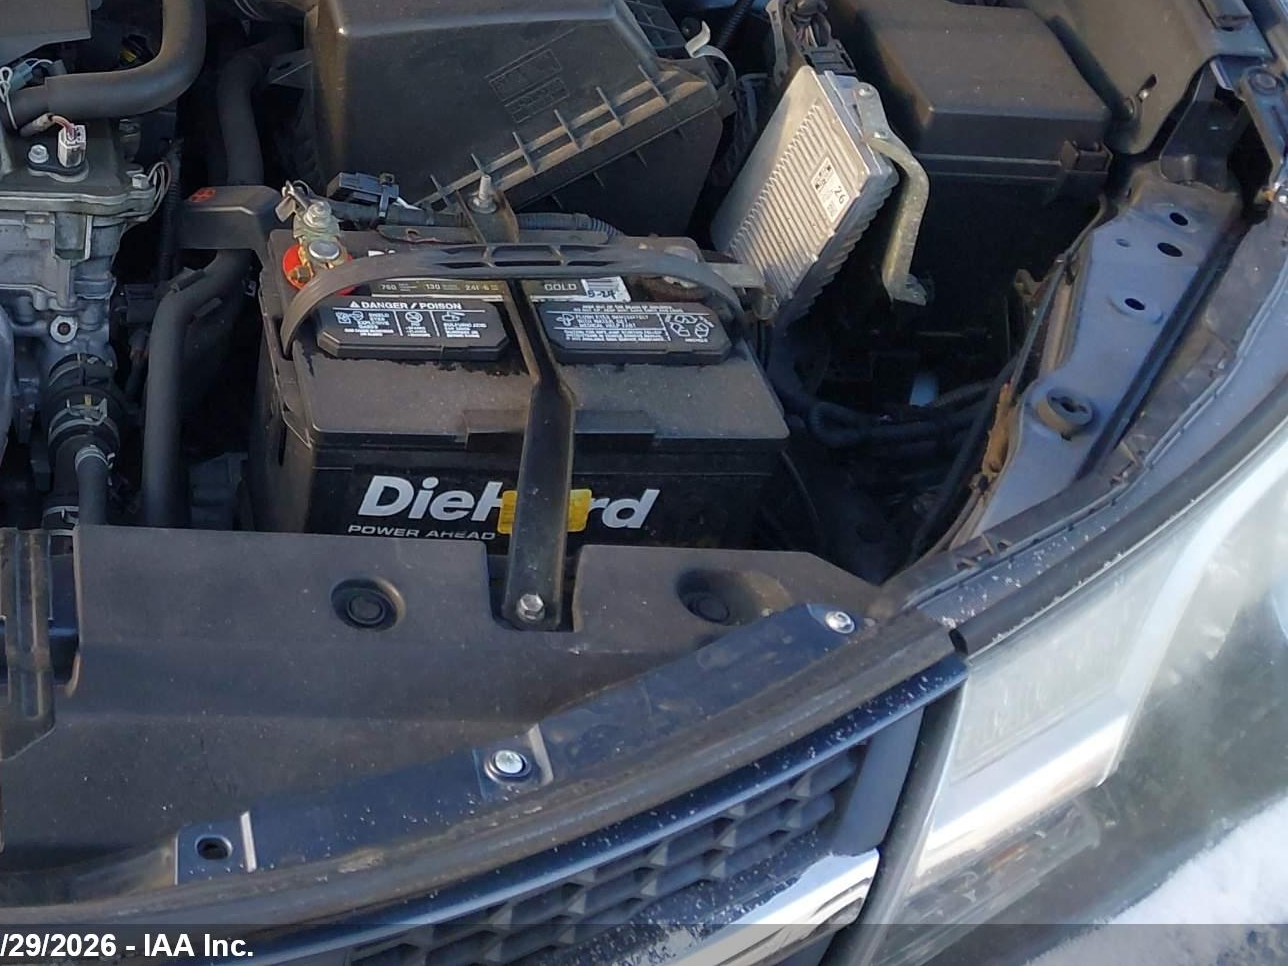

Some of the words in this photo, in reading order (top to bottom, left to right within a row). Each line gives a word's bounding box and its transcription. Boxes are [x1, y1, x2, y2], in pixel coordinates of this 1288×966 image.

[544, 283, 577, 292] GOLD
[361, 301, 409, 310] DANGER
[419, 302, 463, 311] POISON
[347, 524, 419, 538] POWER
[425, 529, 496, 541] AHEAD
